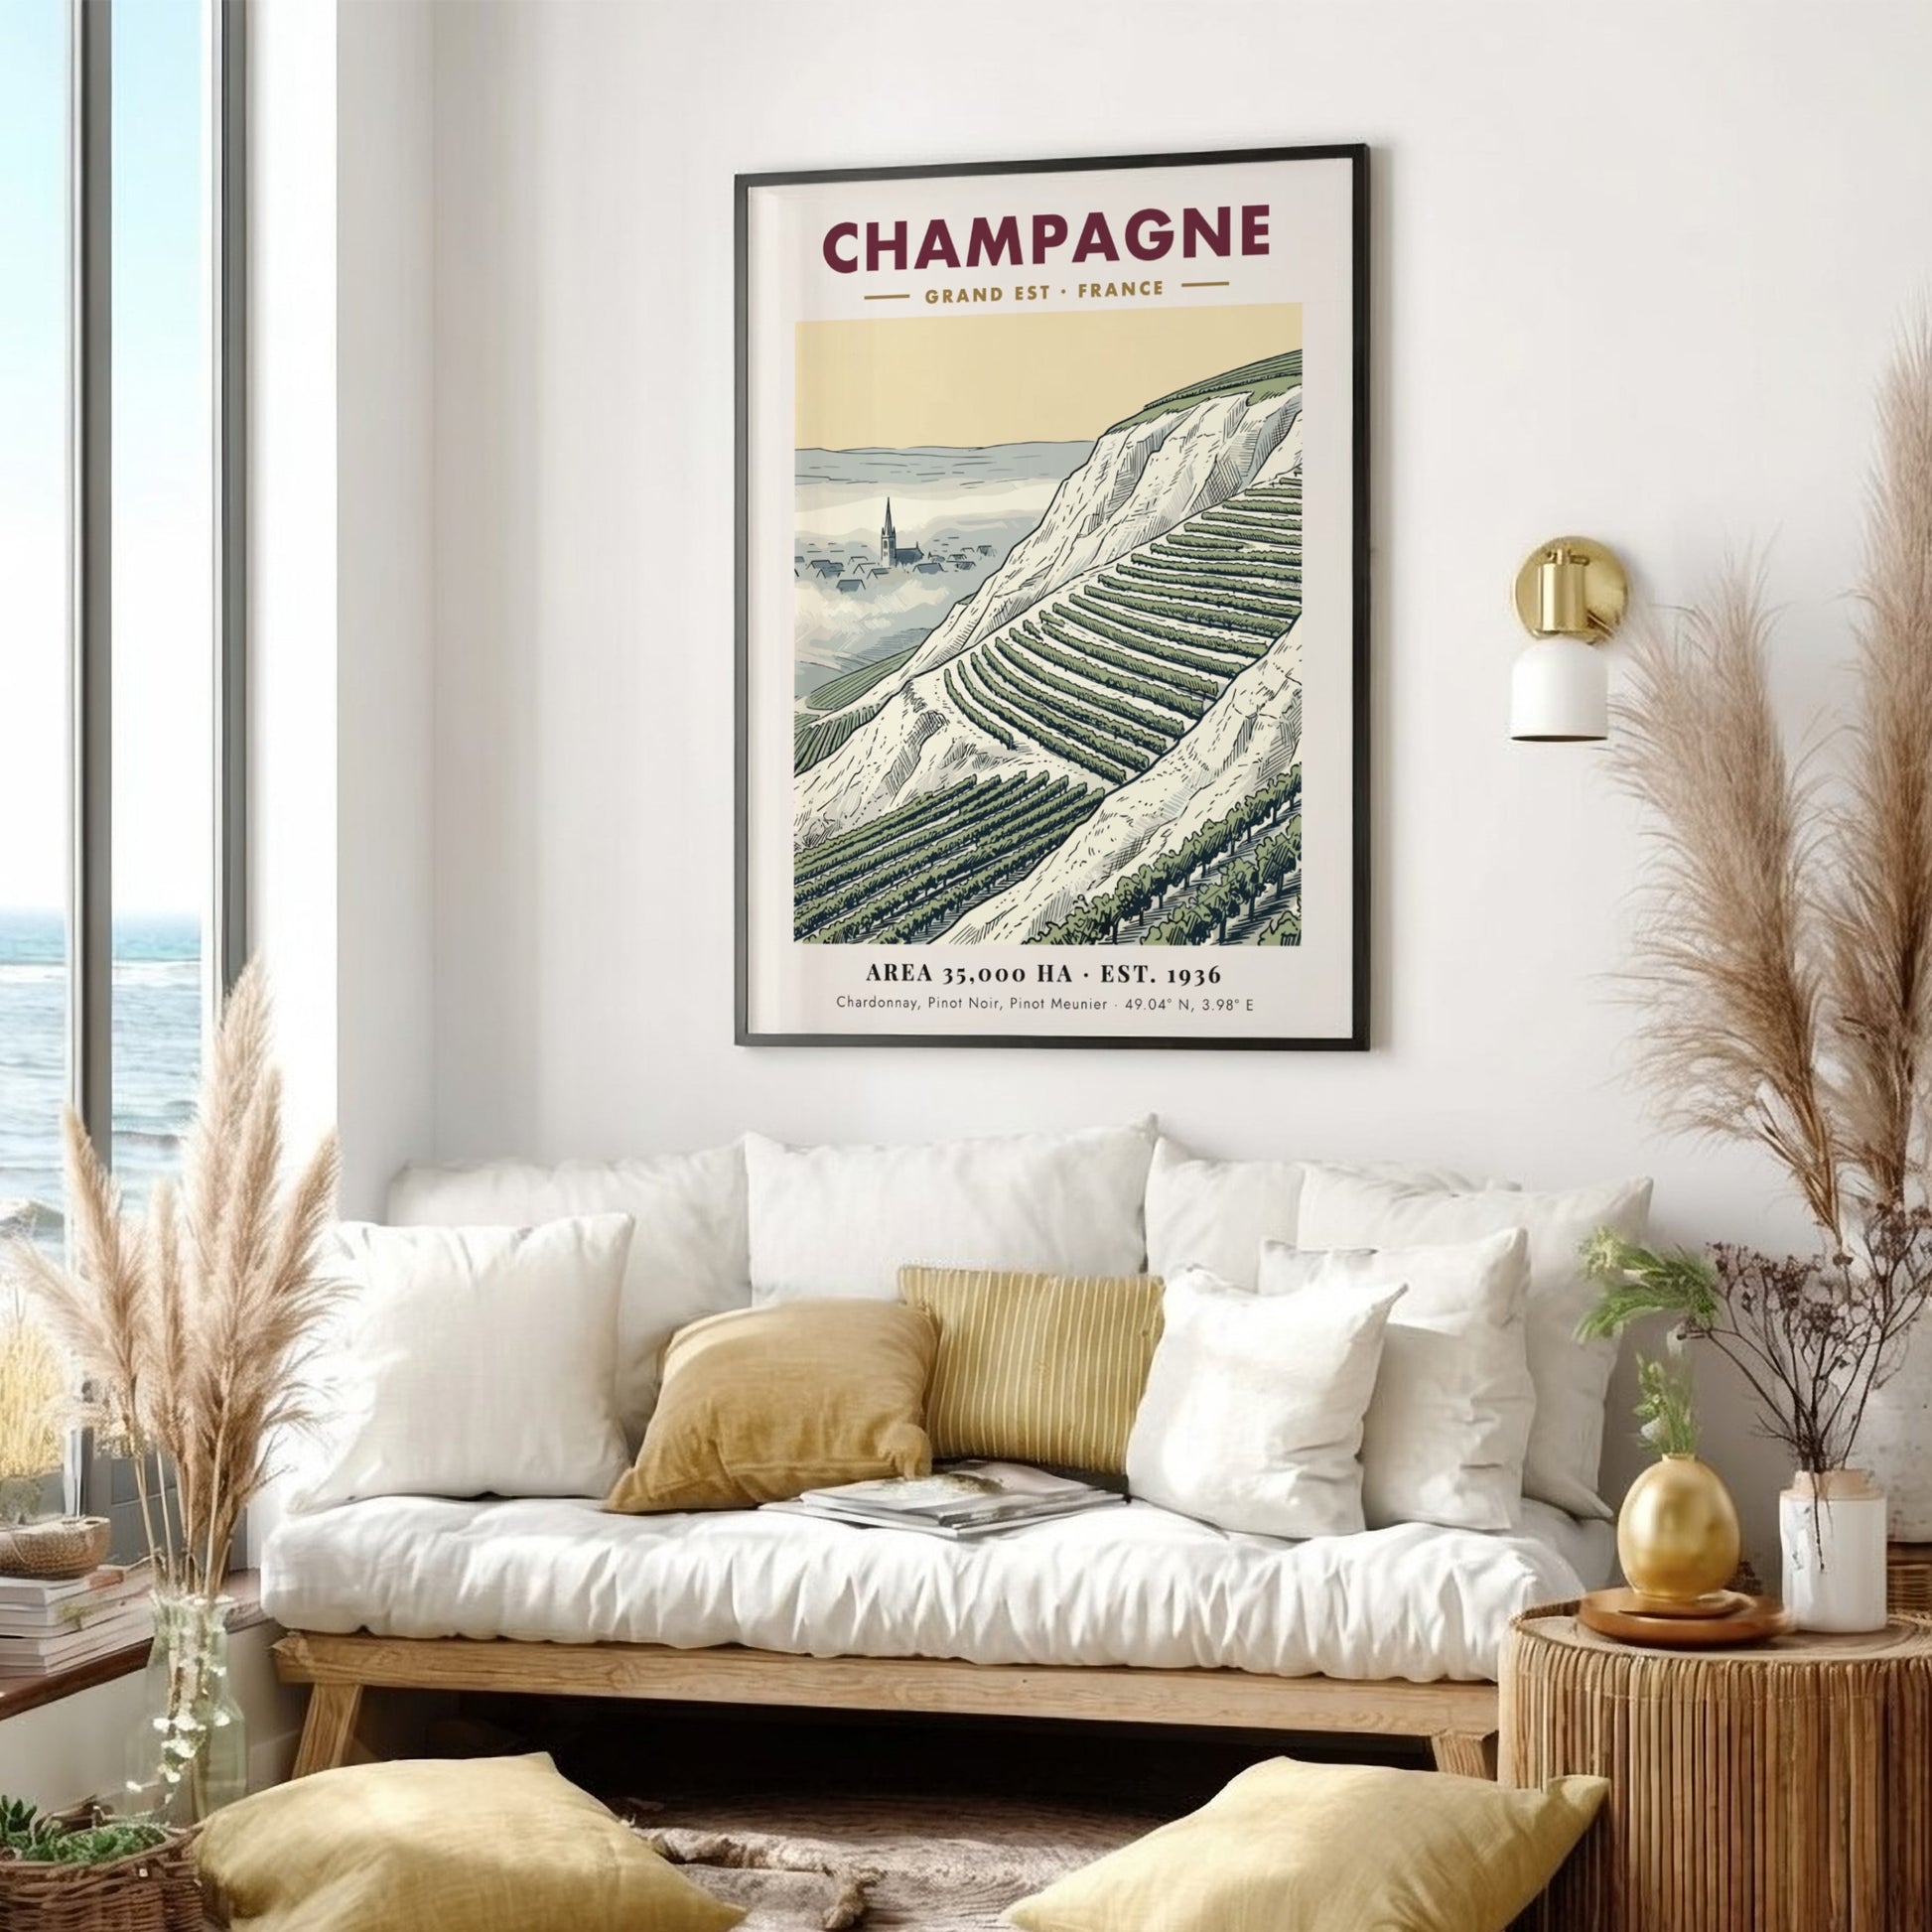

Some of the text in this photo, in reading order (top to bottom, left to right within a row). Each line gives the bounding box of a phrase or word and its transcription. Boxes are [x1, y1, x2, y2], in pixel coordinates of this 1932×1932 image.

[822, 204, 1271, 275] CHAMPAGNE
[924, 280, 1164, 305] GRAND EST FRANCE
[865, 962, 933, 983] AREA
[1036, 963, 1073, 984] HA
[1100, 964, 1157, 984] EST.
[1167, 964, 1221, 988] 1936
[836, 994, 921, 1012] Chardonnay,
[928, 996, 963, 1010] Pinot
[968, 996, 1004, 1012] Noir,
[1010, 996, 1045, 1010] Pinot
[1050, 997, 1108, 1011] Meunier
[1177, 998, 1195, 1014] N,
[1246, 998, 1254, 1012] E
